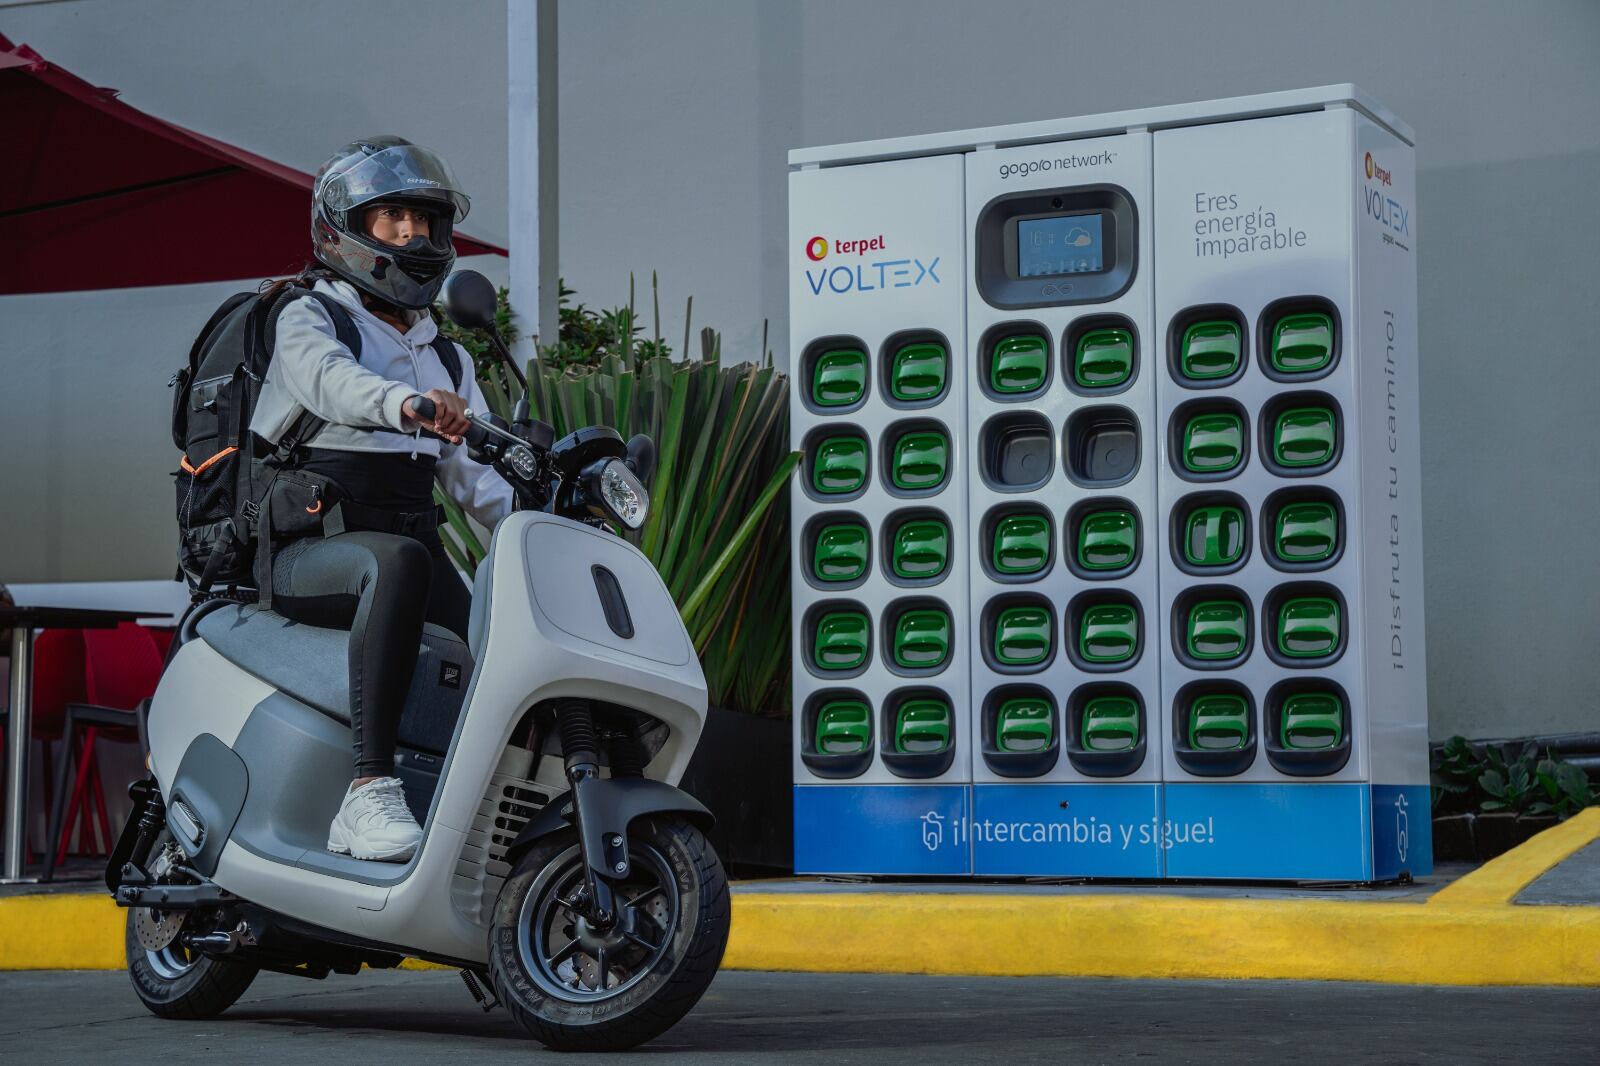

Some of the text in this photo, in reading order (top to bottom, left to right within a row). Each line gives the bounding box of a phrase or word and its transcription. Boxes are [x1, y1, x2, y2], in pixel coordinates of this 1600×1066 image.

[1000, 159, 1051, 179] gogoro
[1374, 162, 1392, 187] terpel
[1195, 192, 1238, 213] Eres
[1364, 185, 1409, 237] VOLTEX
[1195, 205, 1276, 236] energía
[835, 235, 886, 256] terpel
[1195, 227, 1307, 259] imparable
[805, 257, 940, 296] VOLTEX
[1384, 310, 1397, 454] camino!
[1388, 466, 1398, 500] tu
[953, 816, 1215, 850] ¡Intercambia y sigue!
